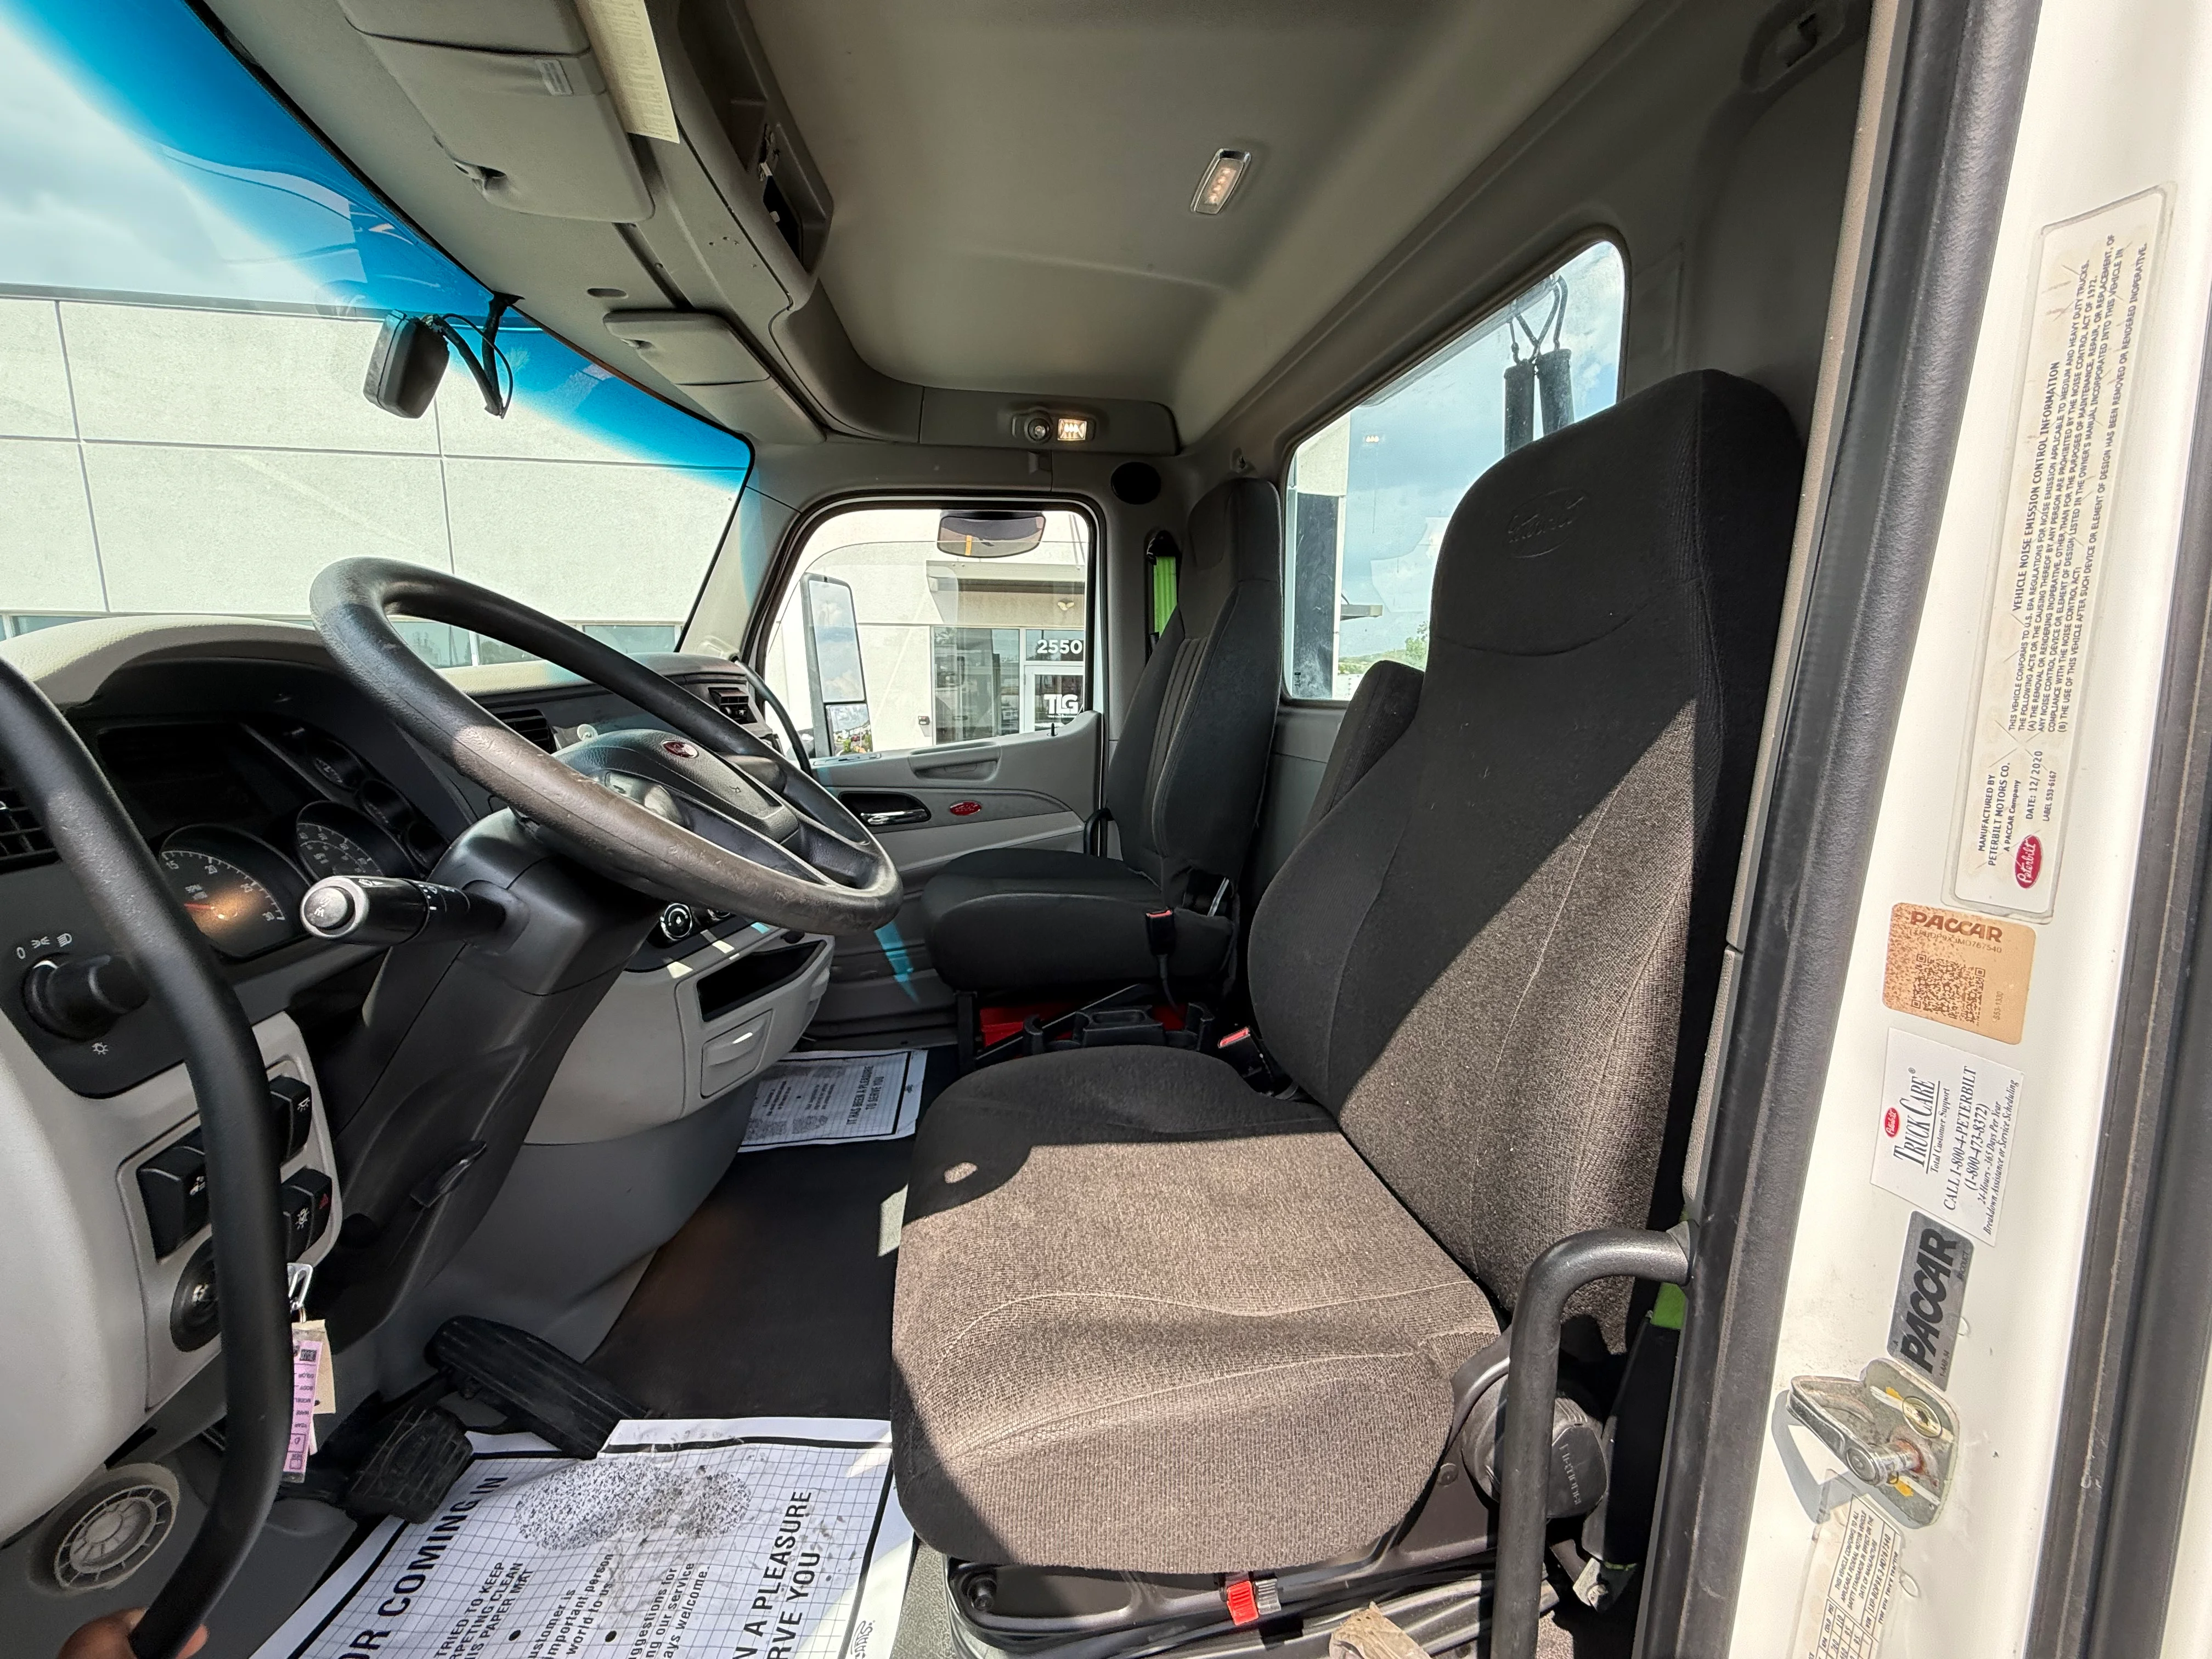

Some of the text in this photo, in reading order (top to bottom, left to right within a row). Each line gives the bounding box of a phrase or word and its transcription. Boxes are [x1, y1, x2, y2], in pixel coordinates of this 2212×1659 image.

[2008, 260, 2089, 730] THIS VEHICLE CONFORMS TO U.S. EPA REGULATIONS FOR NOISE EMISSION APPLICABLE TO MEDIUM AND HEAVY DUTY TRUCKS.
[2012, 362, 2059, 611] VEHICLE NOISE EMISSION CONTROL INFORMATION
[2057, 244, 2147, 732] (B) THE USE OF THIS VEHICLE AFTER SUCH DEVICE OR ELEMENT OF DESIGN HAS BEEN REMOVED OR RENDERED INOPERATIVE.
[2066, 586, 2078, 621] CONTROL
[1037, 639, 1082, 654] 2550
[2058, 648, 2068, 663] THE
[2061, 623, 2072, 646] NOISE
[2055, 665, 2064, 684] WITH
[1043, 694, 1079, 714] TLG
[2048, 687, 2061, 732] COMPLIANCE
[2008, 780, 2021, 813] Company
[2025, 751, 2042, 819] DATE: 12/2020
[1978, 774, 1995, 851] MANUFACTURED BY
[1988, 763, 2010, 865] PETERBILT MOTORS CO.
[2004, 815, 2014, 844] PACCAR
[2042, 803, 2052, 821] LABEL
[2015, 837, 2039, 883] Peterbilt
[1910, 911, 2002, 943] PACCAR
[1893, 1076, 1934, 1165] TRUCK CARE
[1930, 1088, 1950, 1172] Total Customer Support
[1943, 1066, 1975, 1210] CALL 1-800-4-PETERBILT
[1965, 1104, 1989, 1190] (1-800-473-8372)
[1977, 1101, 2001, 1204] 24-Hours 365 Days Per Year
[1983, 1080, 2018, 1234] Breakdown Assistance or Service Scheduling
[1900, 1228, 1957, 1374] PACCAR
[378, 1477, 509, 1617] COMING IN
[752, 1492, 811, 1610] PLEASURE
[1838, 1555, 1848, 1577] VEHICLE
[1844, 1528, 1855, 1556] CONFORMS
[1851, 1520, 1857, 1528] TO
[490, 1562, 523, 1602] CLEAN
[561, 1589, 575, 1601] is
[584, 1554, 614, 1592] person
[661, 1568, 677, 1585] for
[786, 1552, 820, 1602] YOU
[1841, 1572, 1852, 1602] APPLICABLE
[1848, 1551, 1858, 1573] FEDERAL
[1847, 1589, 1855, 1610] SAFETY
[1852, 1560, 1864, 1591] STANDARDS
[1858, 1583, 1866, 1599] DATE
[1862, 1575, 1867, 1584] OF
[433, 1618, 469, 1658] TRIED
[464, 1598, 483, 1615] TO
[478, 1562, 504, 1594] KEEP
[479, 1568, 534, 1639] PAPER MAT
[566, 1583, 613, 1655] world to us
[656, 1563, 695, 1635] our service
[743, 1620, 768, 1638] A
